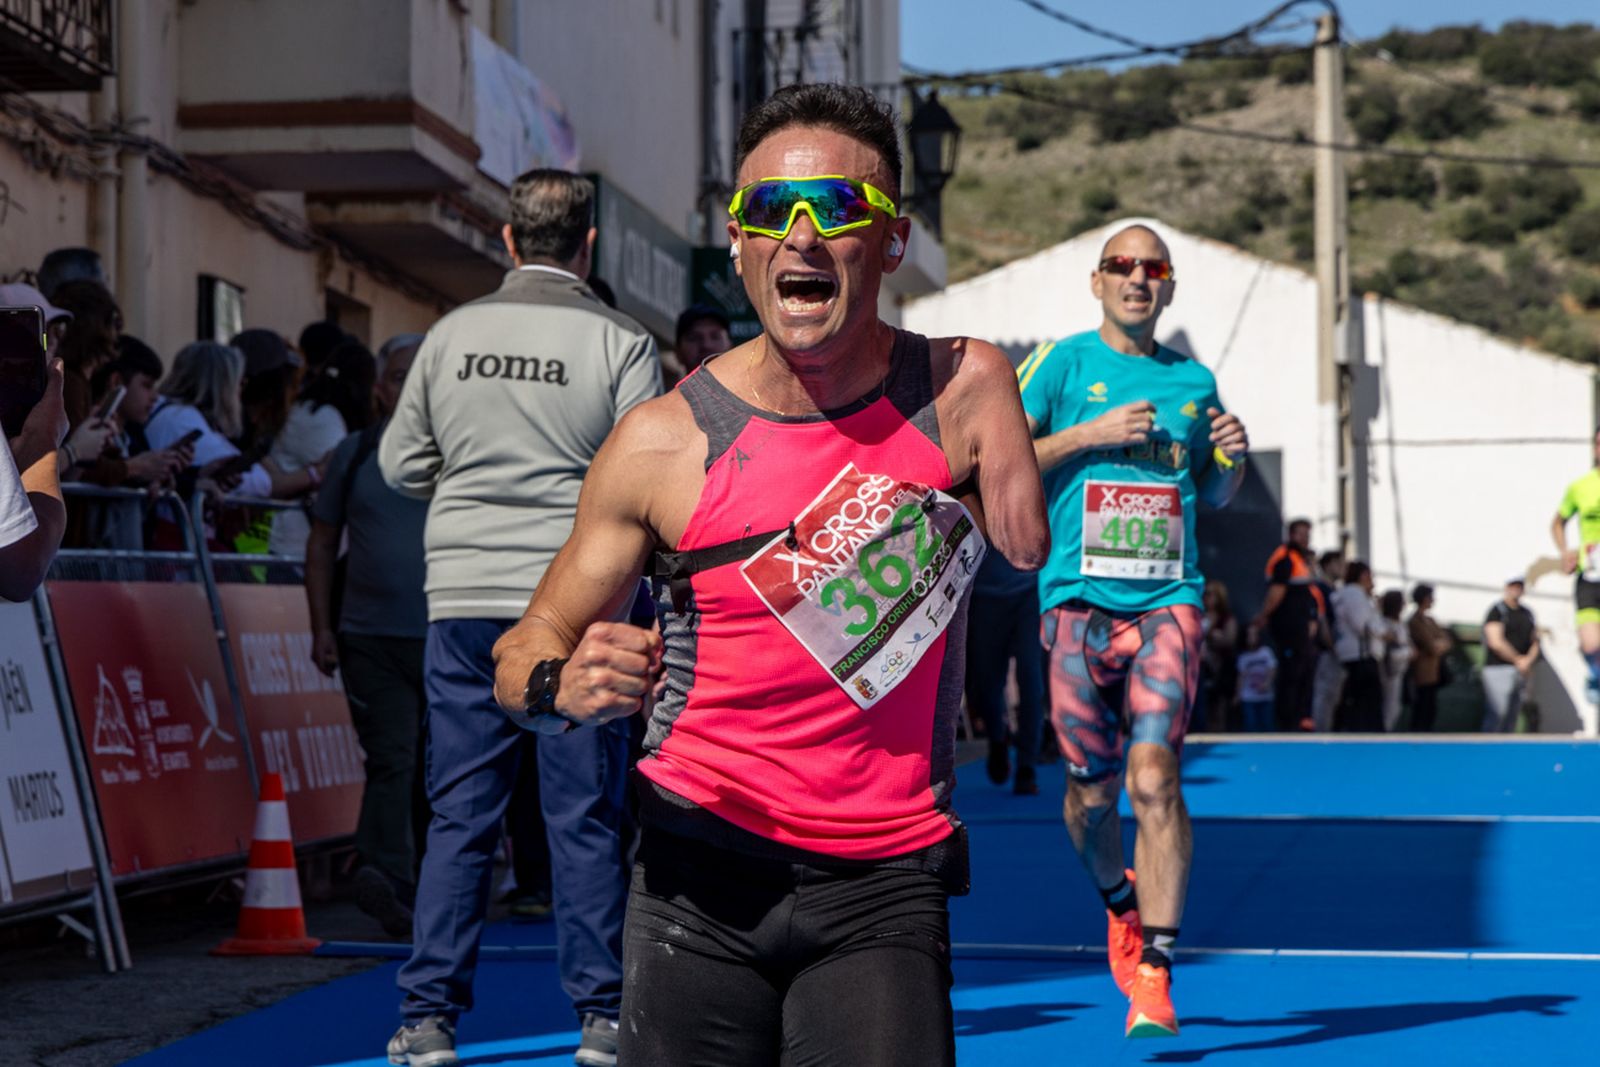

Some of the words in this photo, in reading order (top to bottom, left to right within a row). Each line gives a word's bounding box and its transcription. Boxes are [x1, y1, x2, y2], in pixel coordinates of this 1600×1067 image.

[1101, 487, 1118, 507] X
[1119, 493, 1172, 509] CROSS
[773, 552, 819, 583] X
[810, 473, 894, 553] CROSS
[797, 504, 894, 601] PANTANO
[1100, 516, 1169, 549] 405
[820, 503, 944, 636] 362
[833, 623, 890, 677] FRANCISCO
[7, 770, 64, 825] MARTOS
